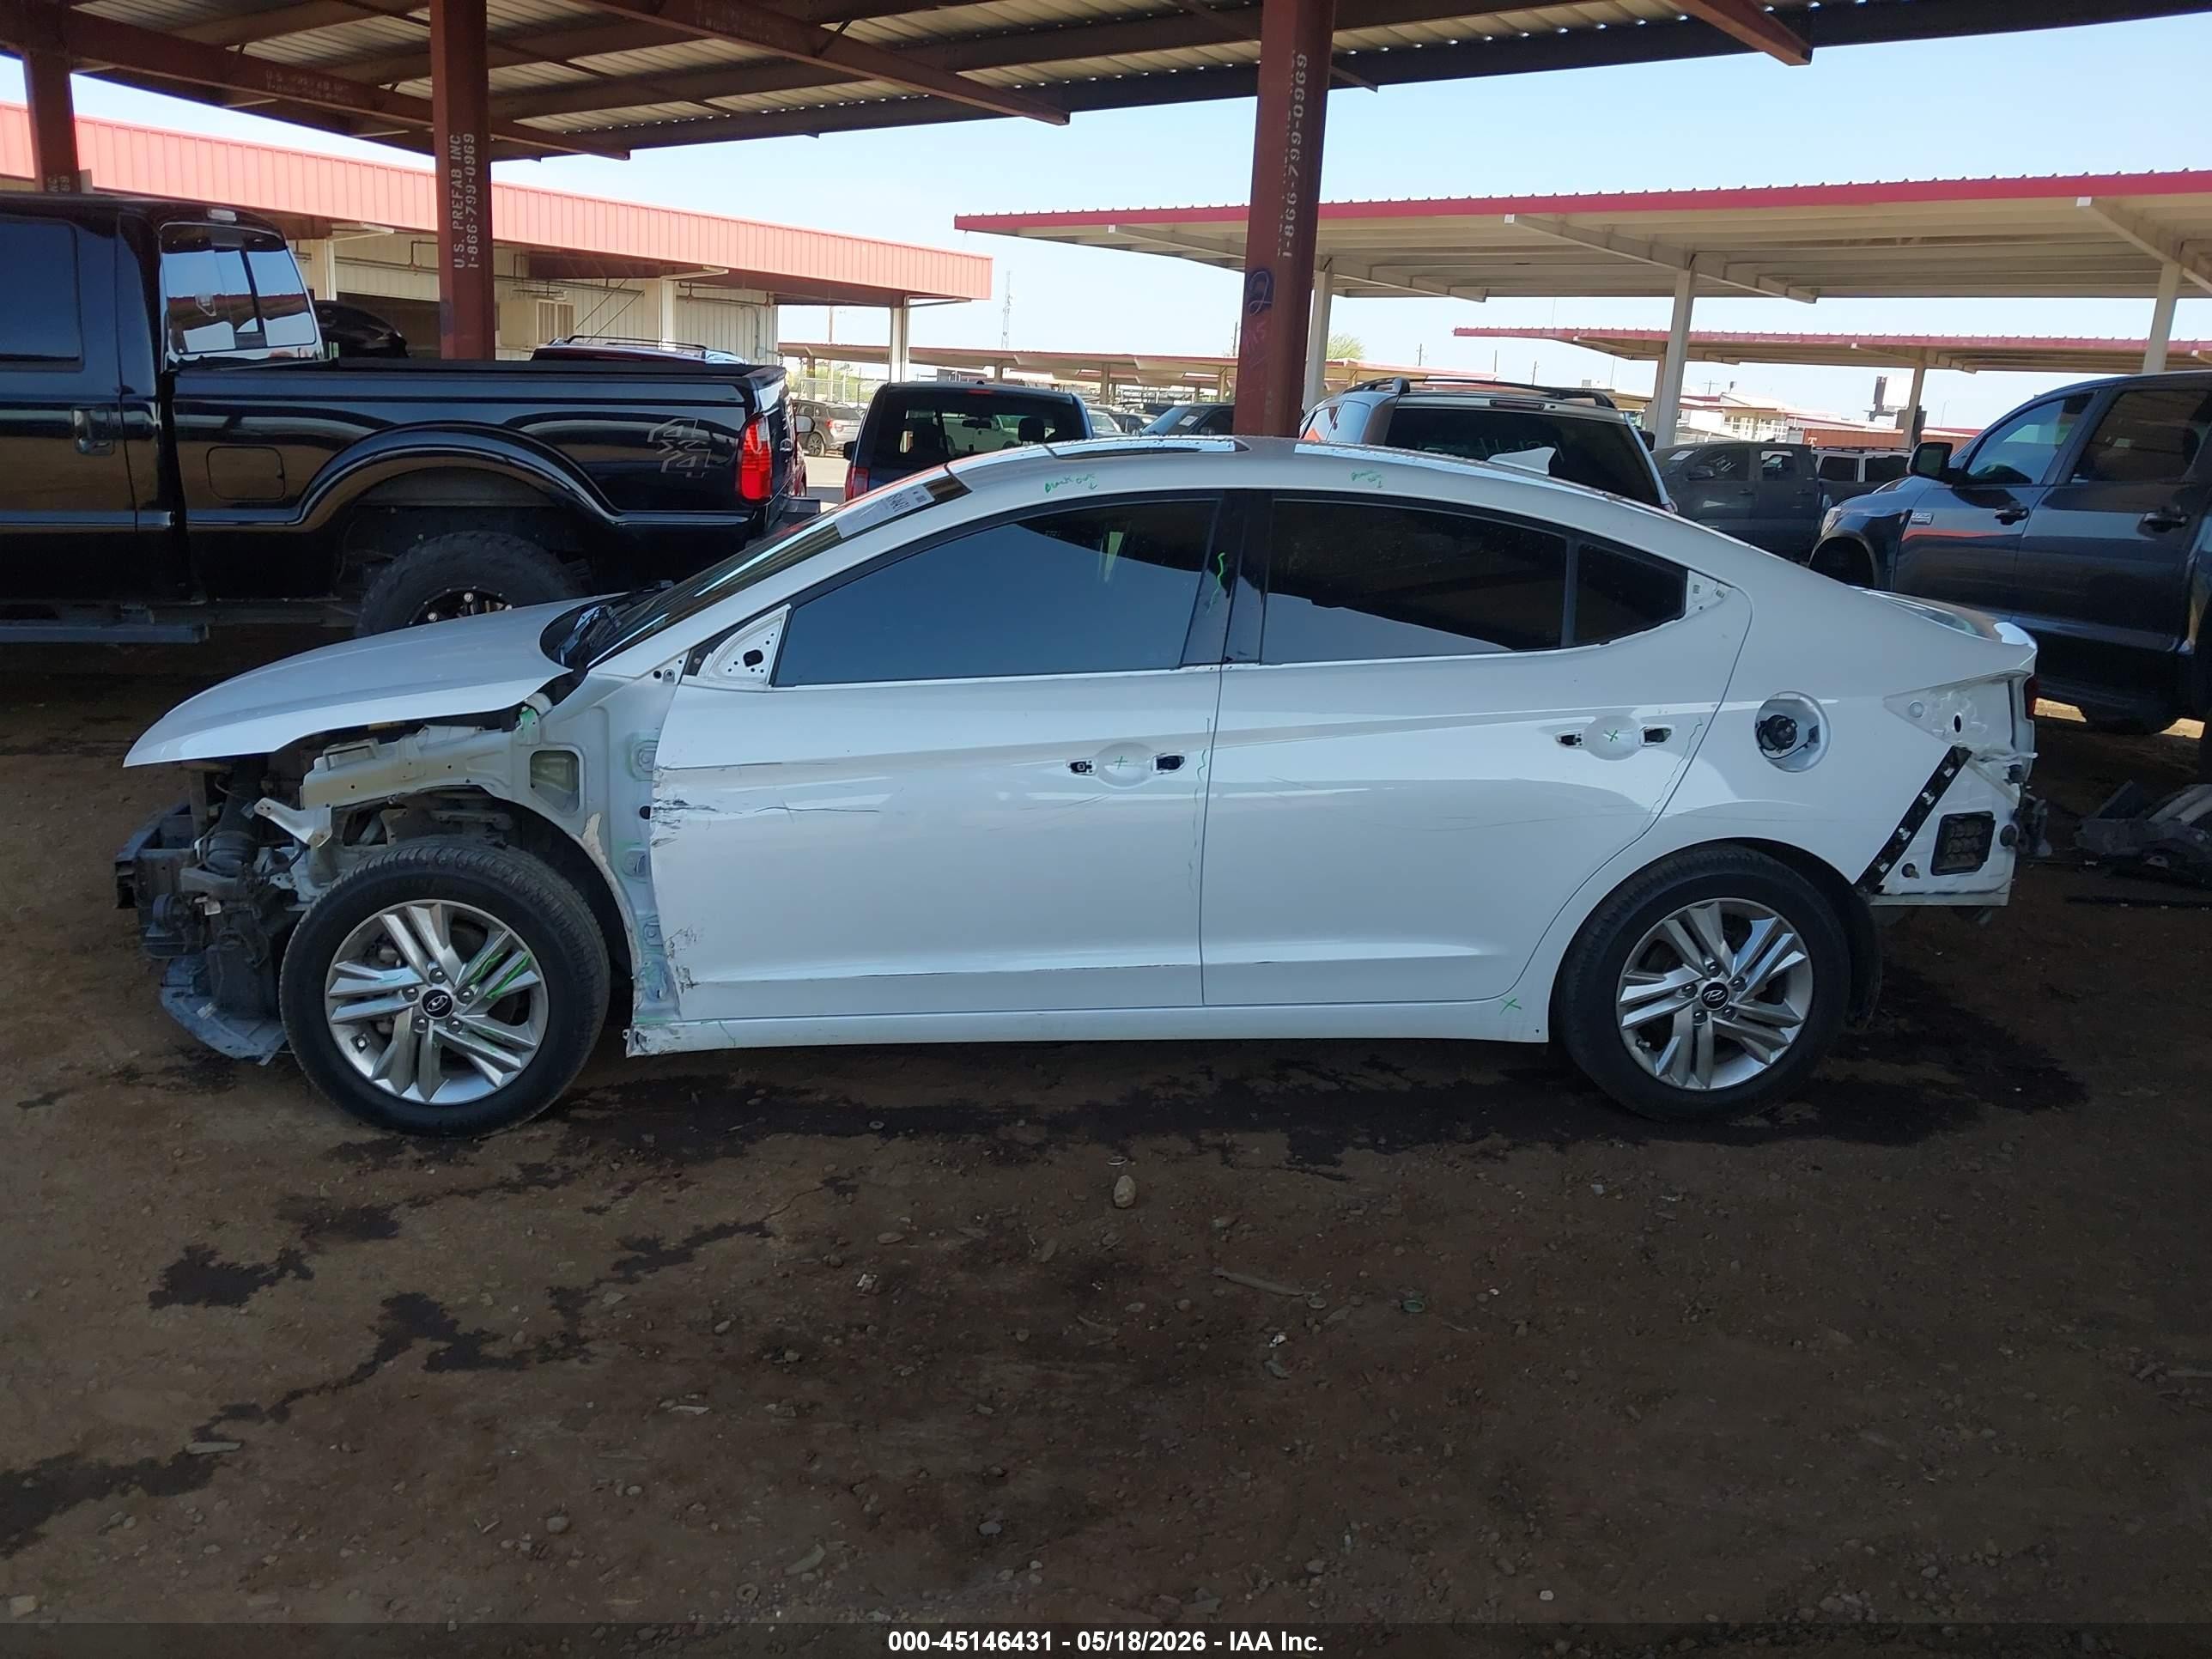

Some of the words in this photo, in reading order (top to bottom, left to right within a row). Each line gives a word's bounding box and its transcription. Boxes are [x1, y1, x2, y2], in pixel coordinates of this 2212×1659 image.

[450, 134, 461, 161] INC
[1283, 53, 1307, 258] 1-866-799-0969
[451, 169, 464, 230] PREFAB
[464, 133, 479, 268] 1-866-799-0969
[453, 240, 465, 268] U.S.
